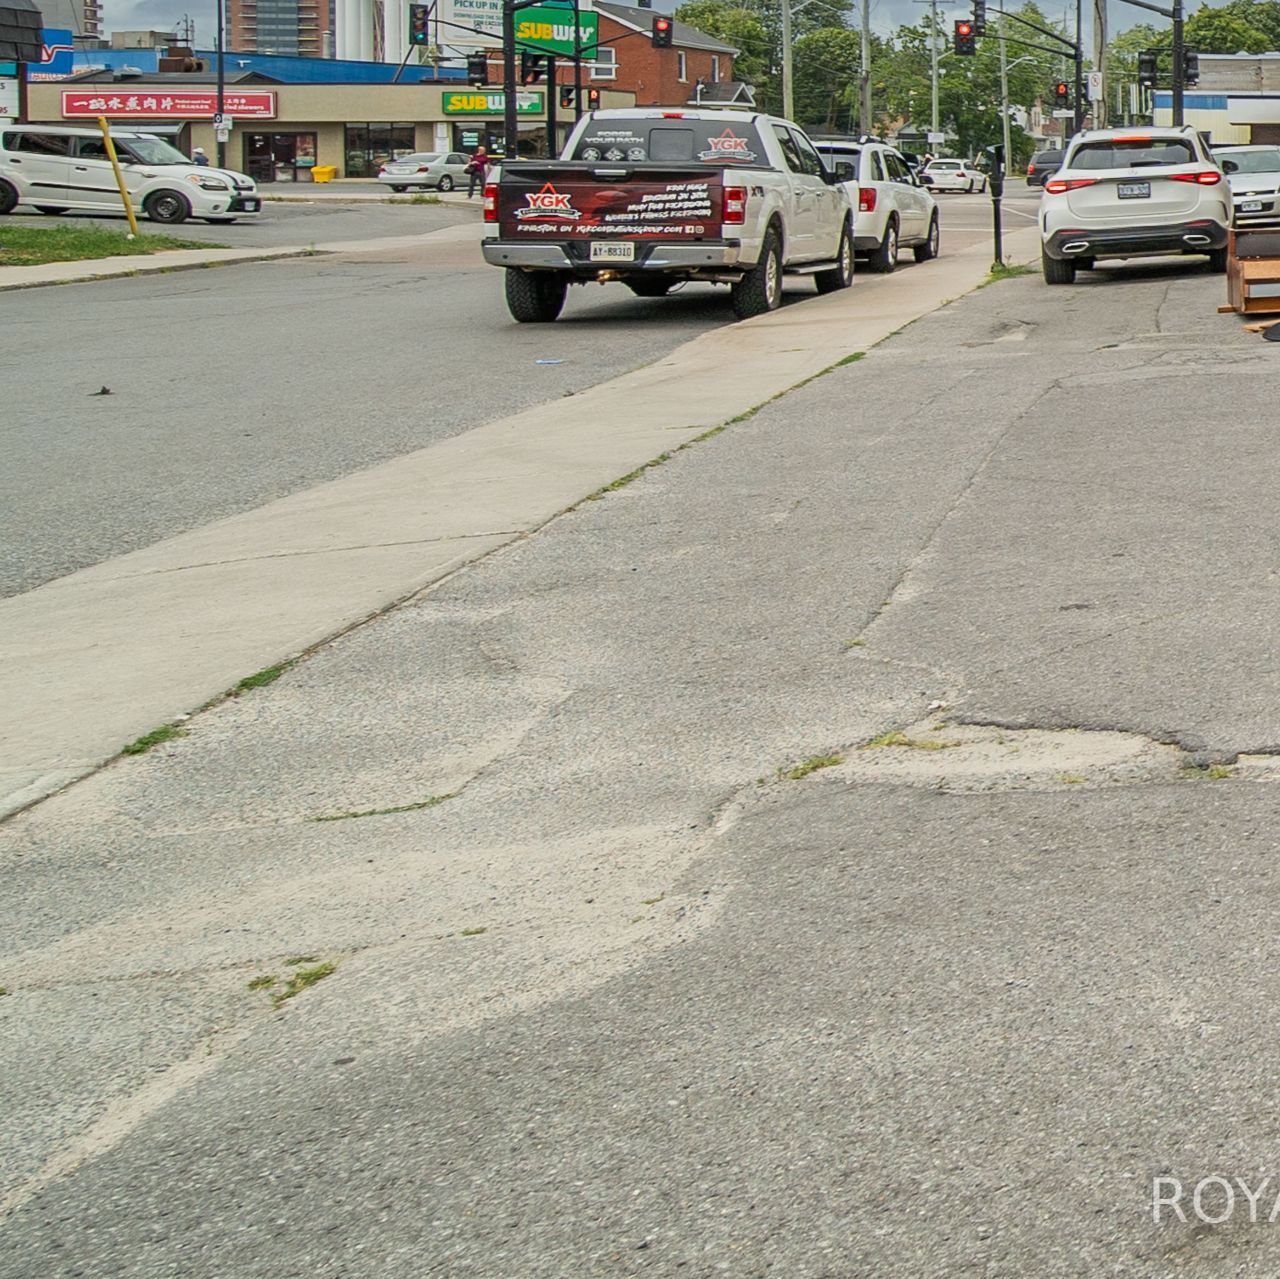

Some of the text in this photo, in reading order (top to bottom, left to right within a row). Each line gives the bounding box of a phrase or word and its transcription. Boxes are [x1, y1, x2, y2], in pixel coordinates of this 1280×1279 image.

[454, 0, 474, 8] PICK
[708, 138, 748, 151] YGK
[525, 193, 571, 209] YGK
